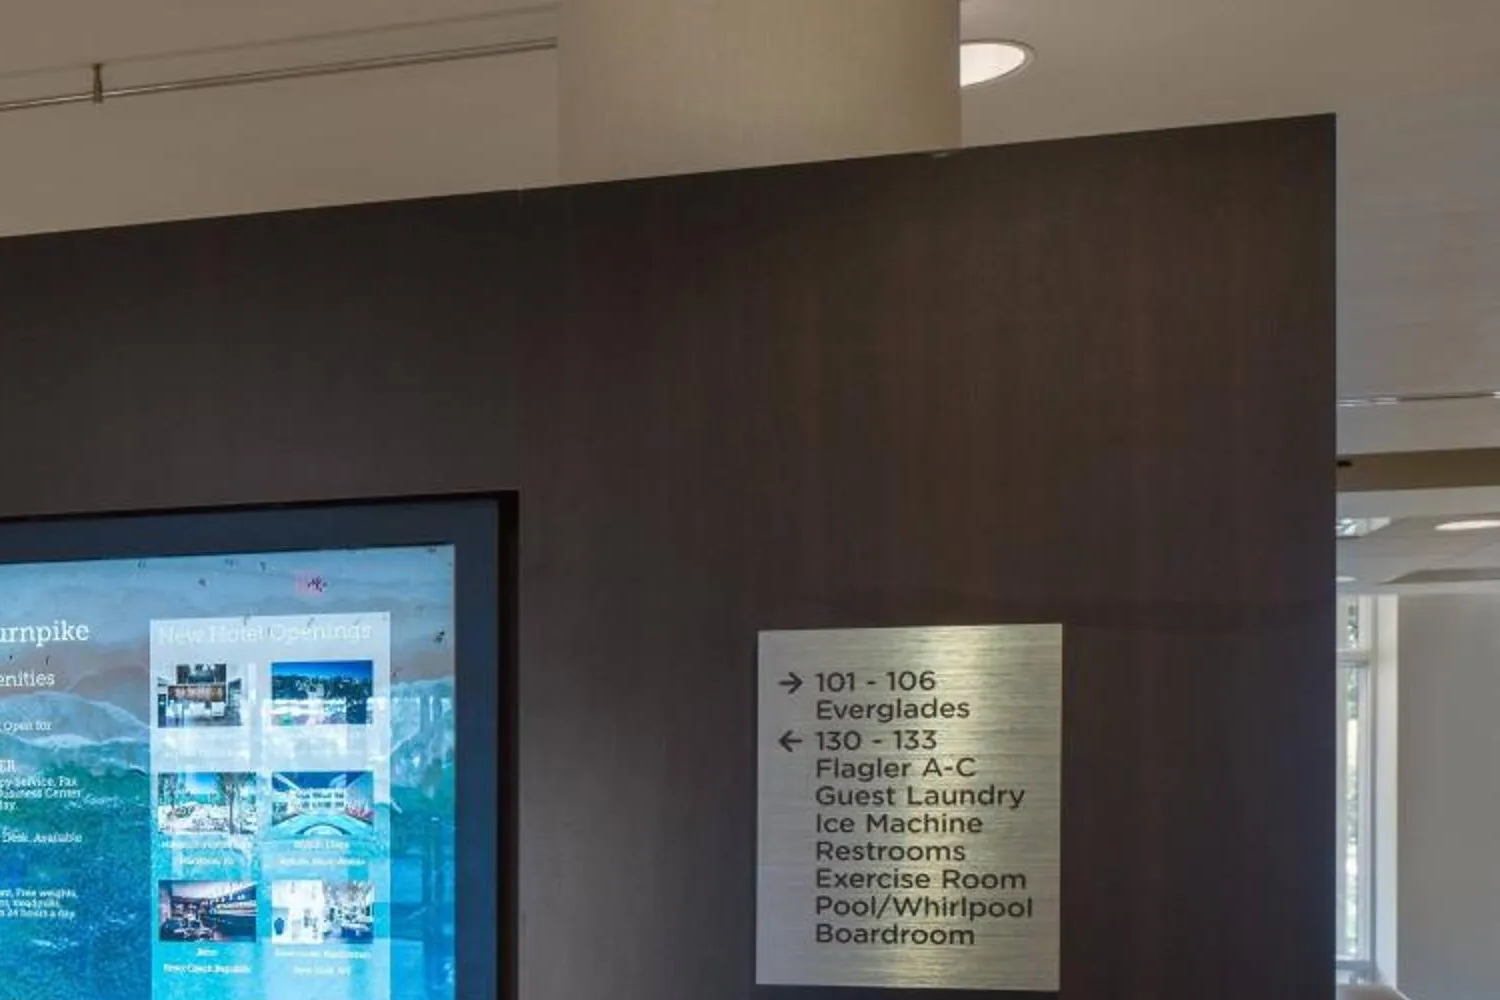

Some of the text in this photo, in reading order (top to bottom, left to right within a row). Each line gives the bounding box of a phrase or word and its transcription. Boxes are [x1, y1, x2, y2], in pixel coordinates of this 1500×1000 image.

[158, 623, 372, 646] New Hotel Openings
[816, 671, 856, 692] 101
[886, 670, 937, 691] 106
[816, 697, 971, 723] Everglades
[816, 731, 861, 751] 130
[893, 730, 938, 750] 133
[816, 757, 977, 783] Flagler A-C
[59, 776, 77, 787] Fax
[816, 784, 1026, 809] Guest Laundry
[816, 813, 984, 834] Ice Machine
[34, 833, 83, 844] Available
[816, 841, 966, 862] Restrooms
[816, 868, 1027, 890] Exercise Room
[816, 895, 1033, 922] Pool/Whirlpool
[816, 923, 976, 945] Boardroom
